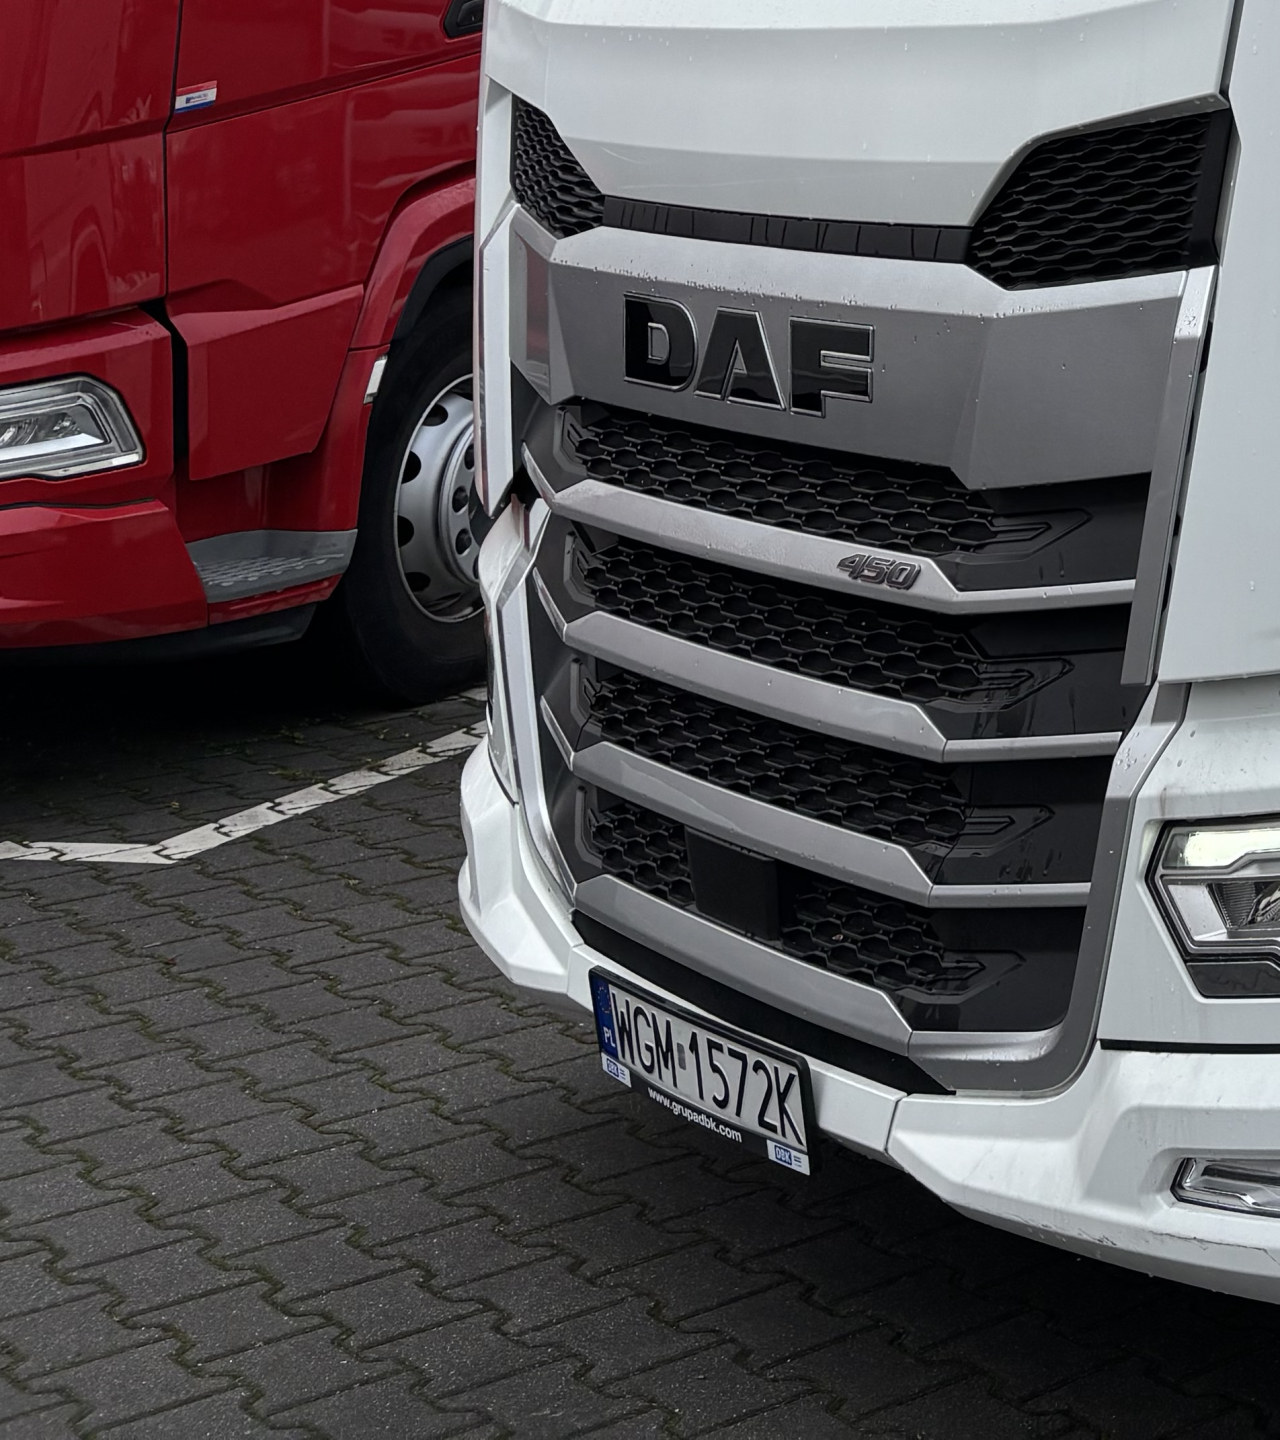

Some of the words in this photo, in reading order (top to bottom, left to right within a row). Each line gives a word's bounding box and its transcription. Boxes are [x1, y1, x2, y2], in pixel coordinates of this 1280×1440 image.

[623, 291, 876, 419] DAF
[836, 552, 922, 591] 450
[603, 1025, 616, 1049] PL
[611, 991, 678, 1089] WGM
[688, 1031, 804, 1146] 1572K
[647, 1086, 743, 1143] www.grupadbk.com
[775, 1147, 792, 1164] DBK
